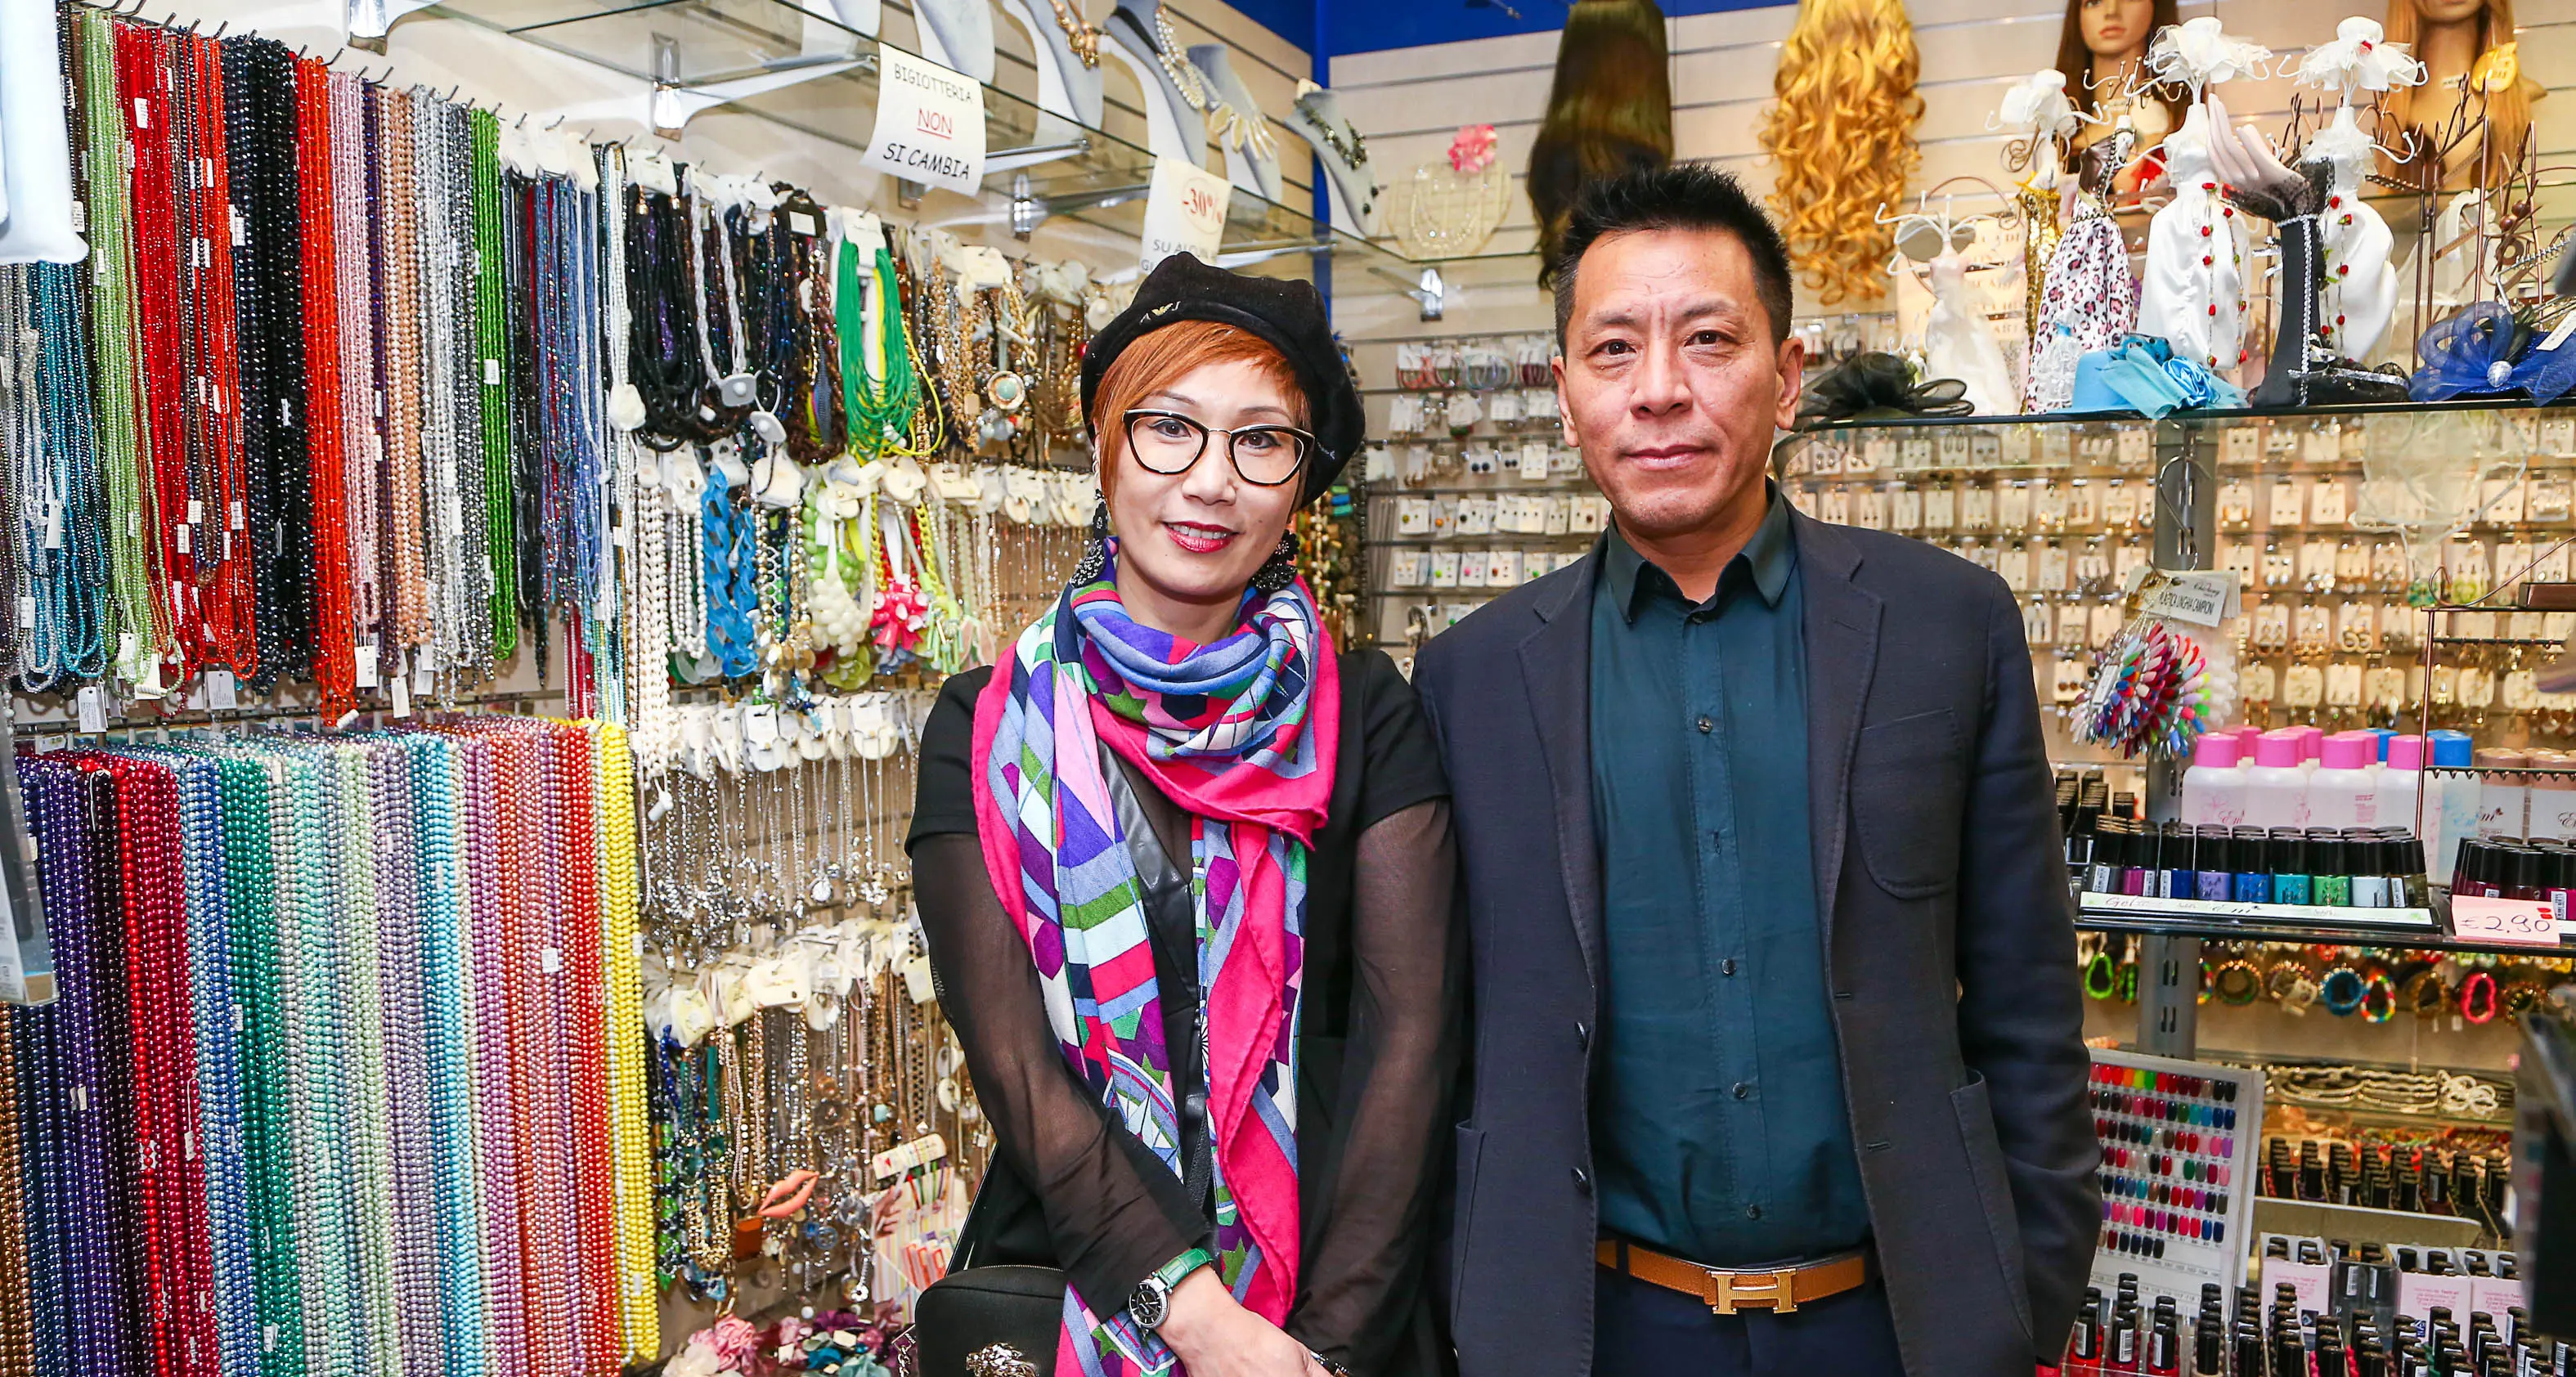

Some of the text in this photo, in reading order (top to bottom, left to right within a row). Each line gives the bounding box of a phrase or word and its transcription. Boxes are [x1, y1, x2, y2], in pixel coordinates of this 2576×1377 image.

[894, 63, 973, 104] BIGIOTTERIA
[918, 108, 954, 135] NON
[883, 143, 970, 182] SI CAMBIA
[1153, 239, 1172, 253] SU
[2460, 914, 2551, 934] €2.90
